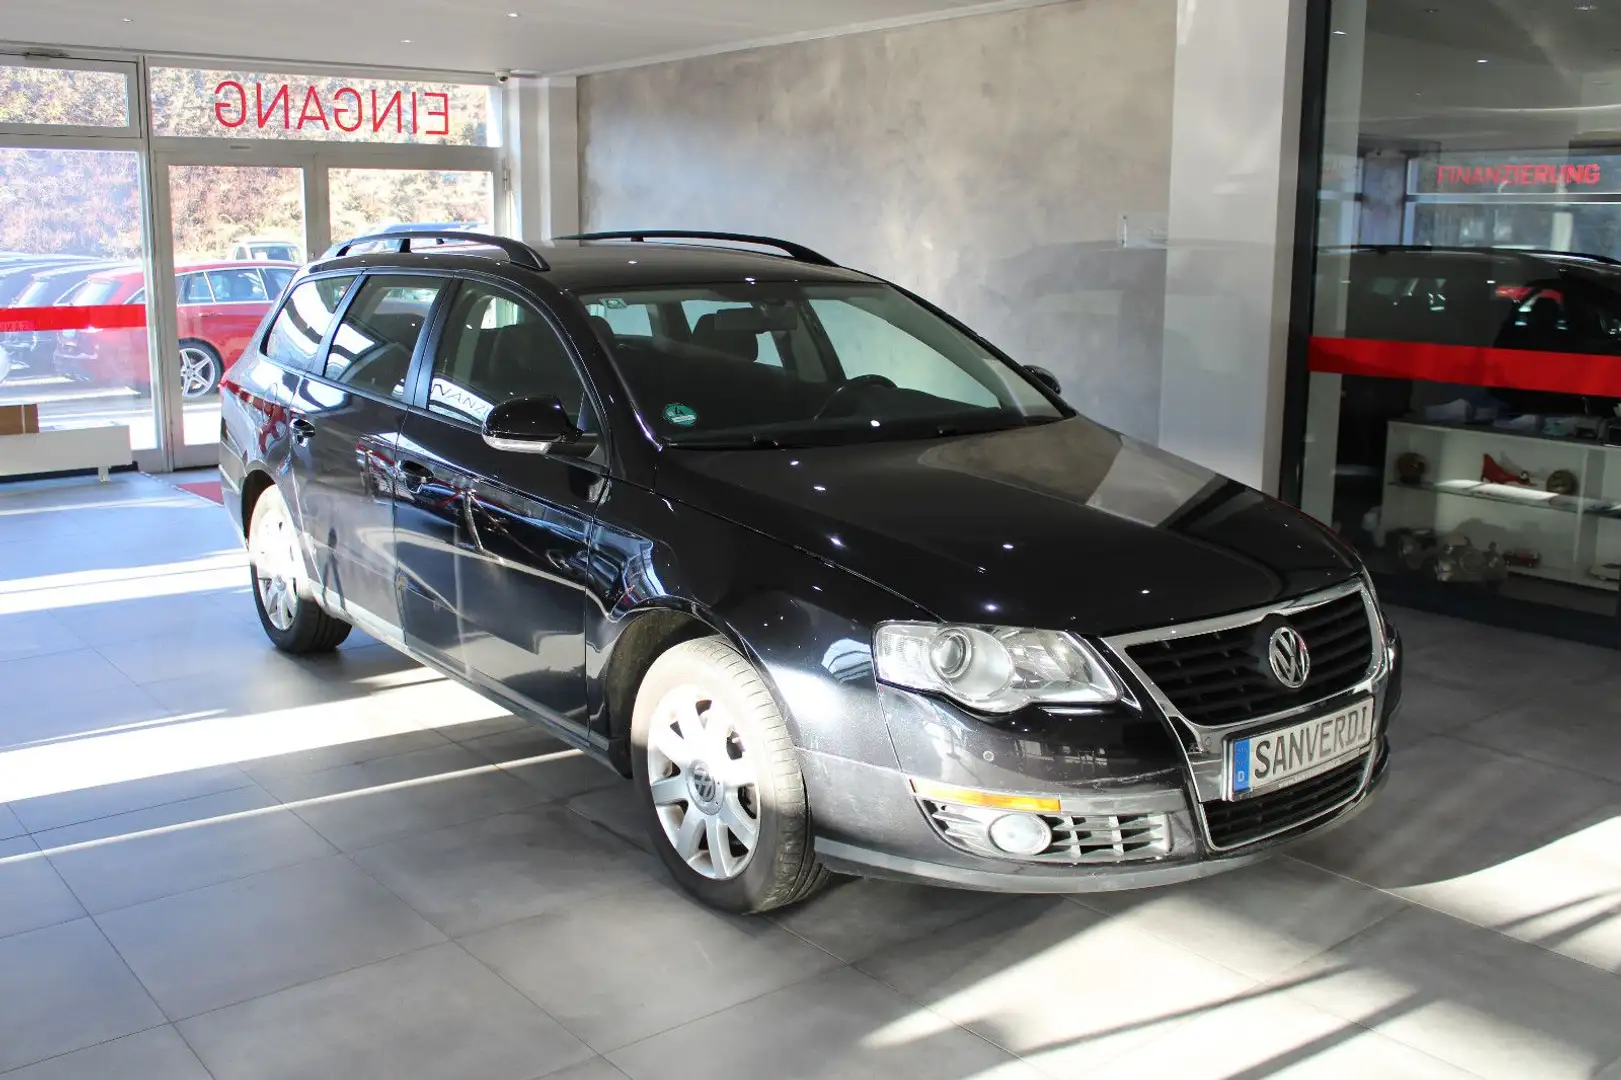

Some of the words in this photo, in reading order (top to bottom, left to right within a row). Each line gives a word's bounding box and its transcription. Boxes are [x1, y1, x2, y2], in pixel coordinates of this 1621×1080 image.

[1436, 163, 1601, 186] FINANZIERUNG
[1254, 706, 1367, 779] SANVERDI
[1237, 770, 1245, 783] D
